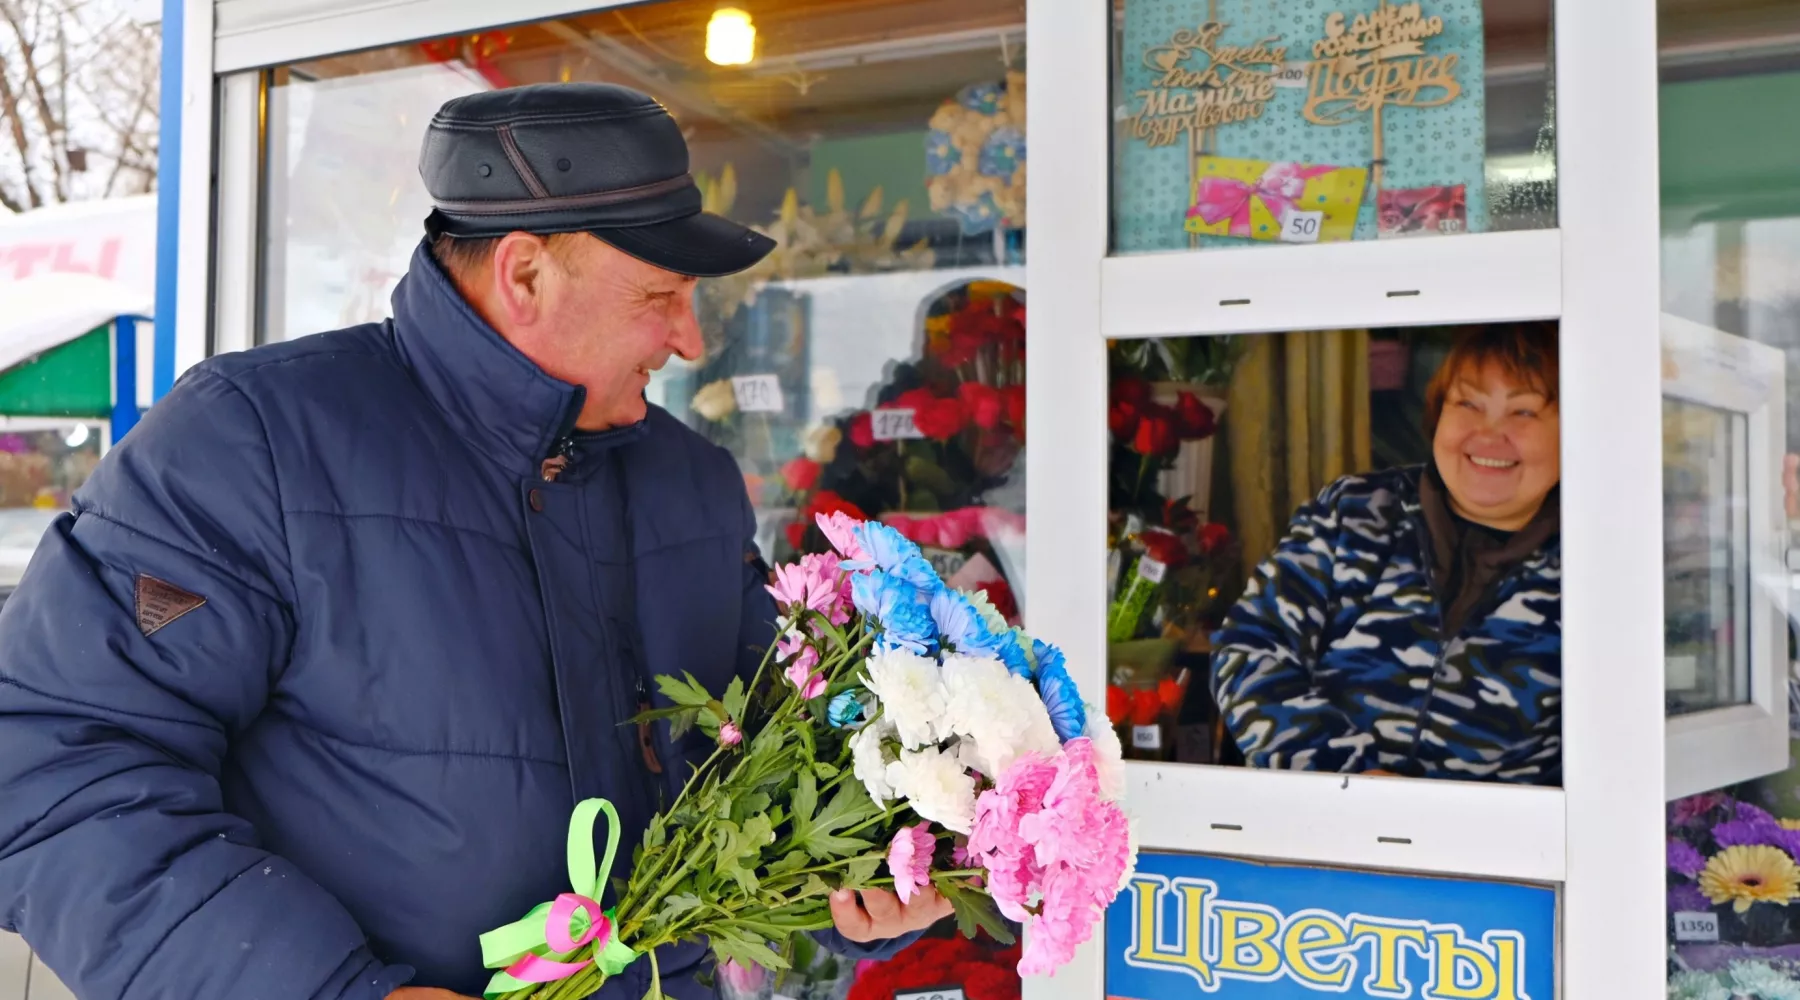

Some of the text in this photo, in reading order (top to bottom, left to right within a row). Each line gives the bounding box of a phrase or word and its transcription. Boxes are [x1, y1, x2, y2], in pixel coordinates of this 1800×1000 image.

[1302, 53, 1461, 126] Подруге
[1290, 217, 1316, 235] 50
[1441, 220, 1459, 232] 10
[0, 238, 120, 279] ТЫ
[740, 379, 771, 407] 170
[1126, 873, 1526, 1000] Цветы
[1680, 920, 1714, 932] 1350
